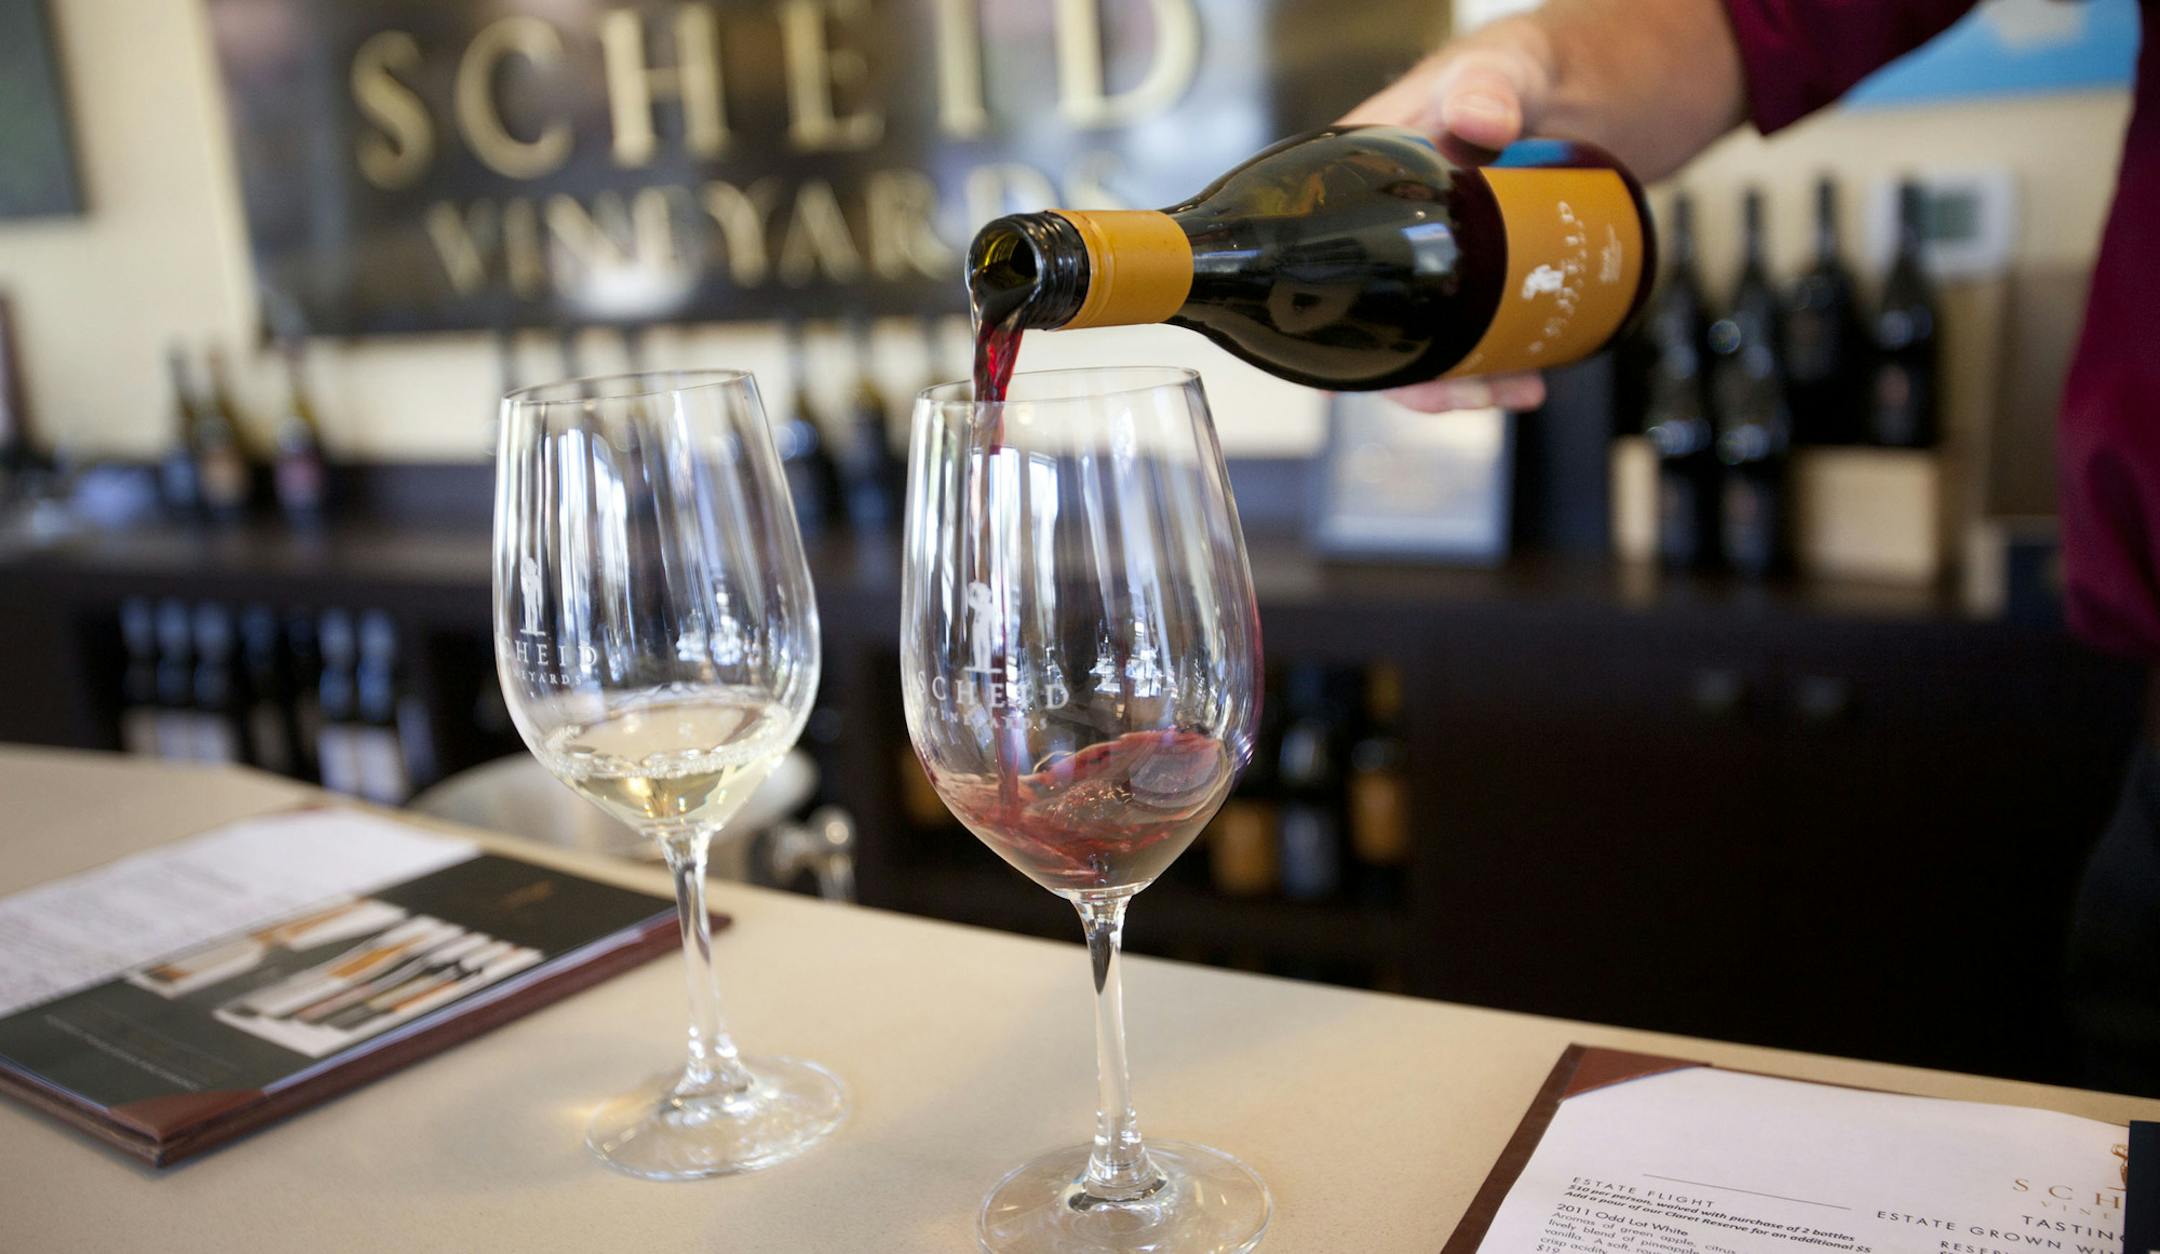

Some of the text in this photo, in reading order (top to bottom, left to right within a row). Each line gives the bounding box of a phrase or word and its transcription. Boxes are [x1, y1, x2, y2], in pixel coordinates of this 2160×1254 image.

[348, 0, 1202, 192] SCHEID
[502, 636, 597, 667] CHEID
[917, 671, 1070, 710] SCHEID
[930, 705, 1049, 731] VINEARDS
[1573, 1176, 1715, 1208] ESTATE FLIGHT
[1548, 1218, 1577, 1231] lively
[1583, 1226, 1616, 1239] blend
[1552, 1211, 1596, 1227] Aromas
[1602, 1222, 1616, 1230] of
[1620, 1226, 1654, 1239] green
[1556, 1202, 1690, 1237] 2011 Odd Lot White
[1564, 1191, 1588, 1200] Add
[1597, 1198, 1626, 1208] pour
[1642, 1207, 1666, 1216] our
[1665, 1210, 1701, 1224] Claret
[1701, 1217, 1749, 1232] Reserve
[1749, 1227, 1770, 1236] for
[1771, 1230, 1787, 1240] an
[1789, 1234, 1854, 1251] additional
[1590, 1189, 1611, 1197] per
[1656, 1201, 1700, 1215] waived
[1701, 1209, 1727, 1220] with
[1728, 1215, 1784, 1231] purchase
[1786, 1225, 1802, 1234] of
[1811, 1228, 1856, 1242] bottles
[1876, 1210, 1956, 1231] ESTATE
[1969, 1226, 2061, 1249] GROWN
[1540, 1237, 1567, 1247] crisp
